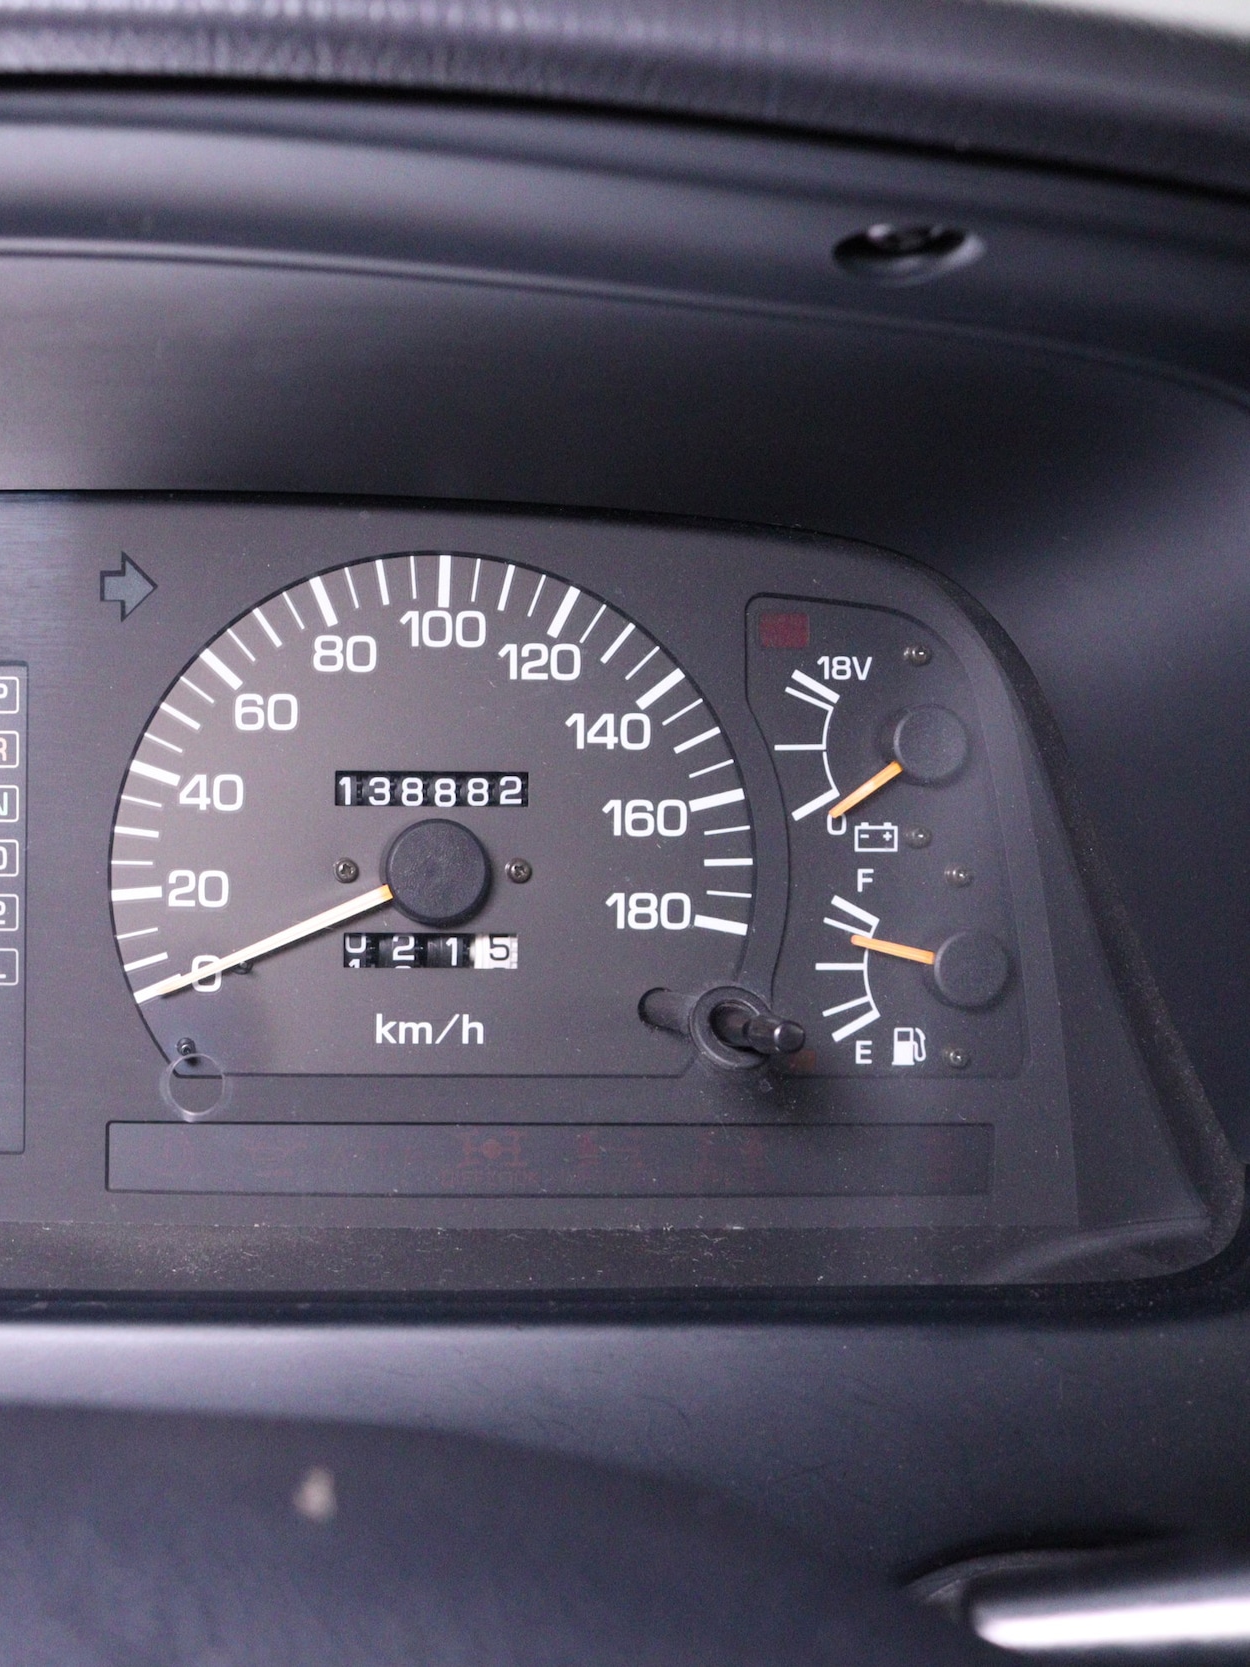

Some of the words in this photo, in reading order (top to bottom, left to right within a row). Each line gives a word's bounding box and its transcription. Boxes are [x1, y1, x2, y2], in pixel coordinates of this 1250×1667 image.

[399, 609, 487, 648] 100
[312, 634, 377, 673] 80
[497, 642, 581, 681] 120
[816, 655, 873, 681] 18V
[234, 693, 299, 731] 60
[564, 712, 651, 751] 140
[179, 773, 244, 812] 40
[338, 775, 523, 808] 138882
[601, 799, 688, 838] 160
[826, 811, 847, 836] 0
[168, 869, 230, 908] 20
[857, 868, 875, 893] F
[605, 892, 692, 931] 180
[191, 954, 223, 993] 0
[375, 1013, 484, 1045] km/h
[855, 1040, 873, 1065] E
